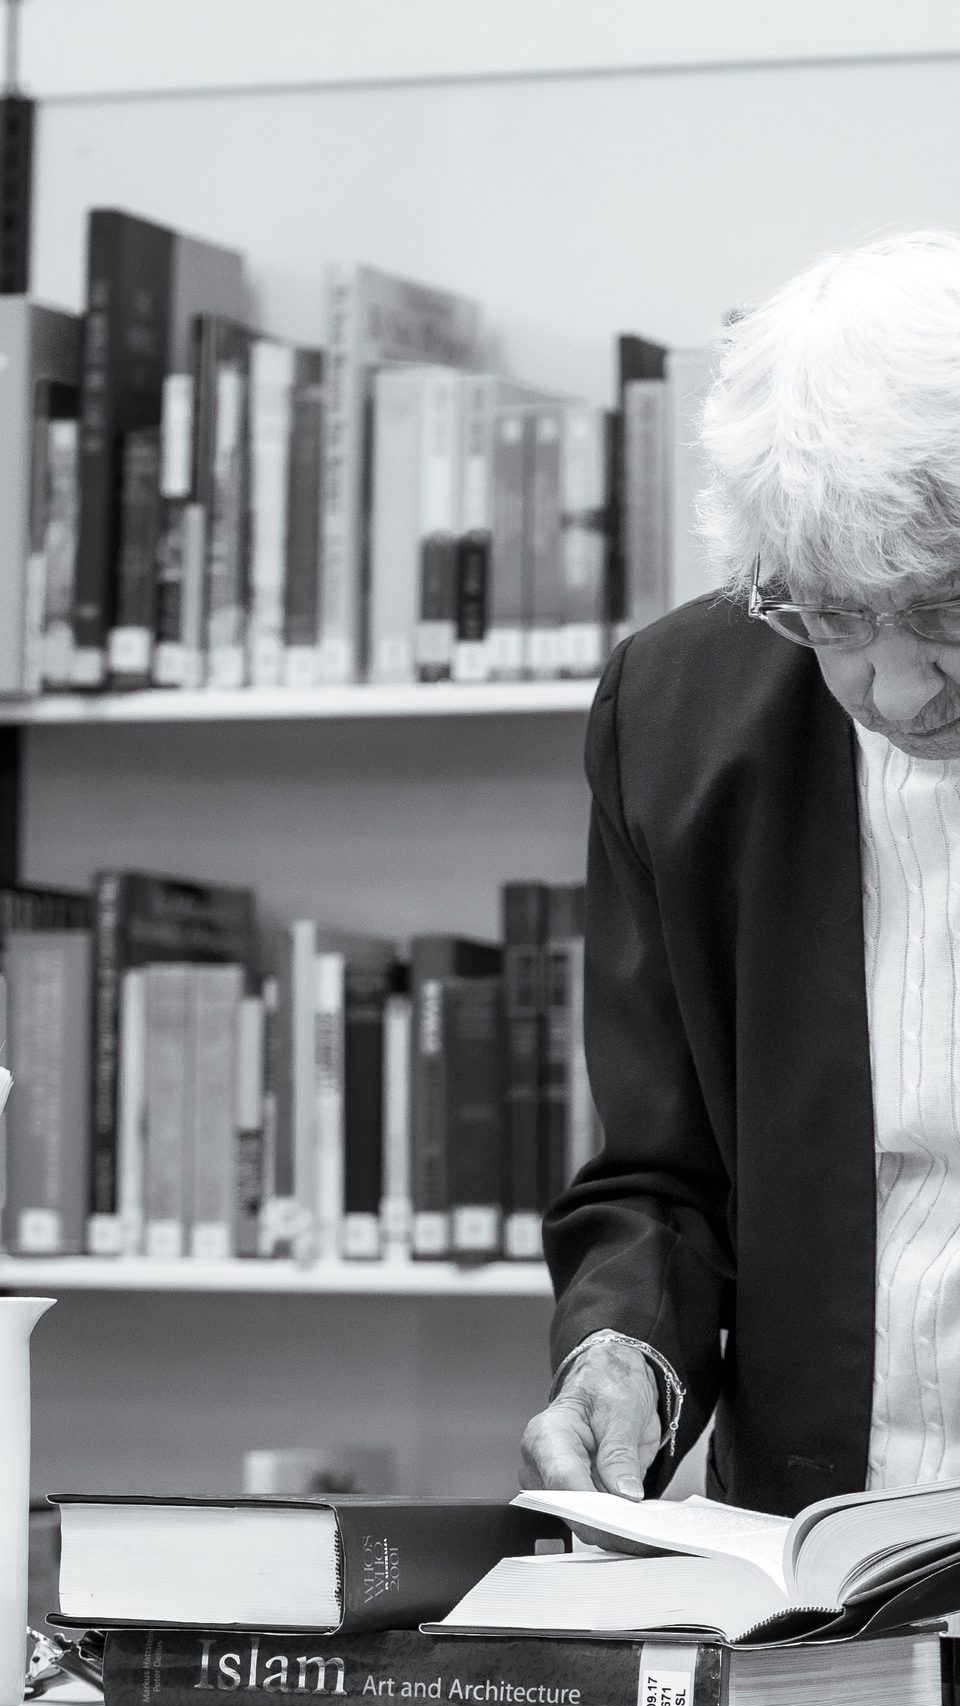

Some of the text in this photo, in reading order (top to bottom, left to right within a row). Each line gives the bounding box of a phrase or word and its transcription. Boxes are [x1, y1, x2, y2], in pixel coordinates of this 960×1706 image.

[374, 1541, 385, 1598] WHO
[389, 1548, 400, 1591] 2001
[153, 1669, 161, 1693] Peter
[194, 1636, 348, 1695] Islam
[142, 1670, 150, 1703] Markus
[362, 1675, 581, 1705] Art and Architecture
